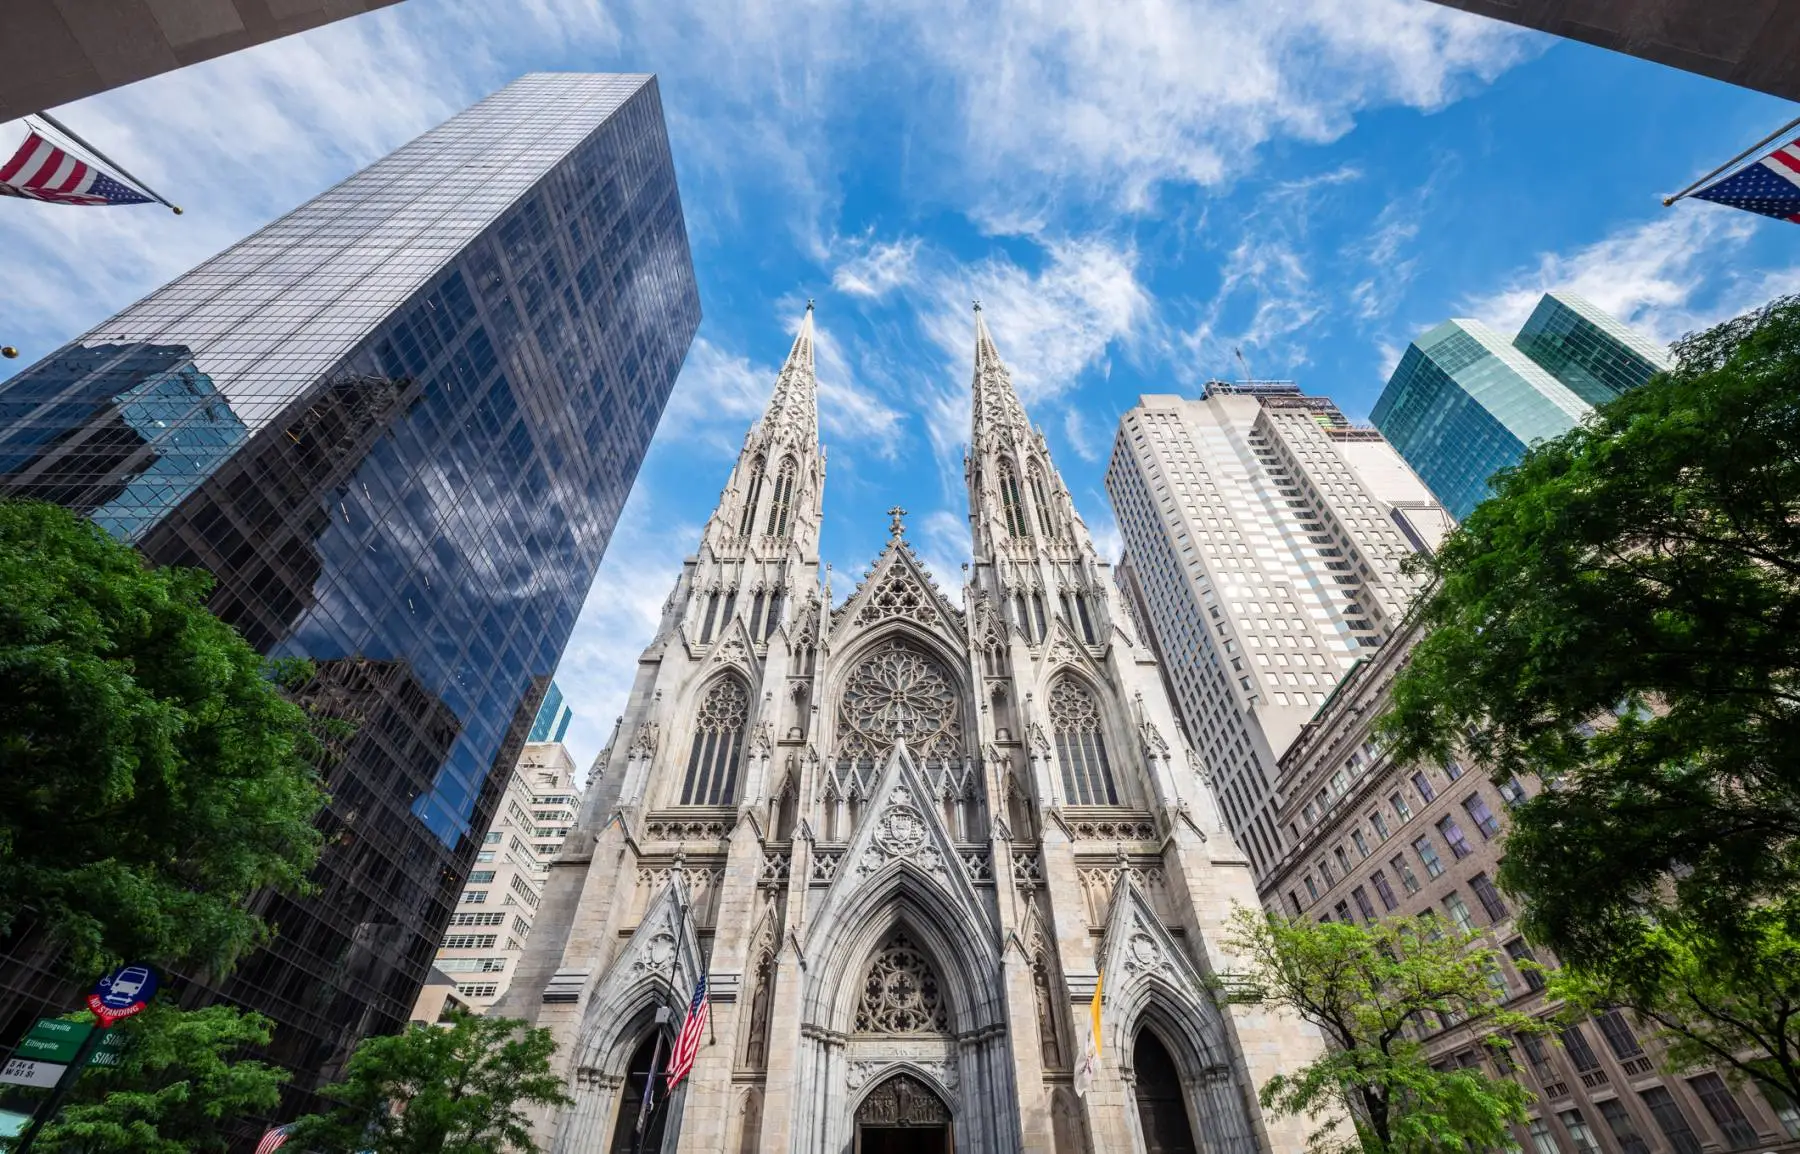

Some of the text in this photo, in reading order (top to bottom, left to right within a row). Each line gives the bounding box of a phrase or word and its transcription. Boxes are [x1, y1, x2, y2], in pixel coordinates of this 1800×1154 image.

[90, 998, 100, 1008] NO
[98, 1004, 139, 1017] STANDING
[9, 1060, 16, 1068] 5
[16, 1061, 26, 1069] Av
[14, 1069, 25, 1077] 51
